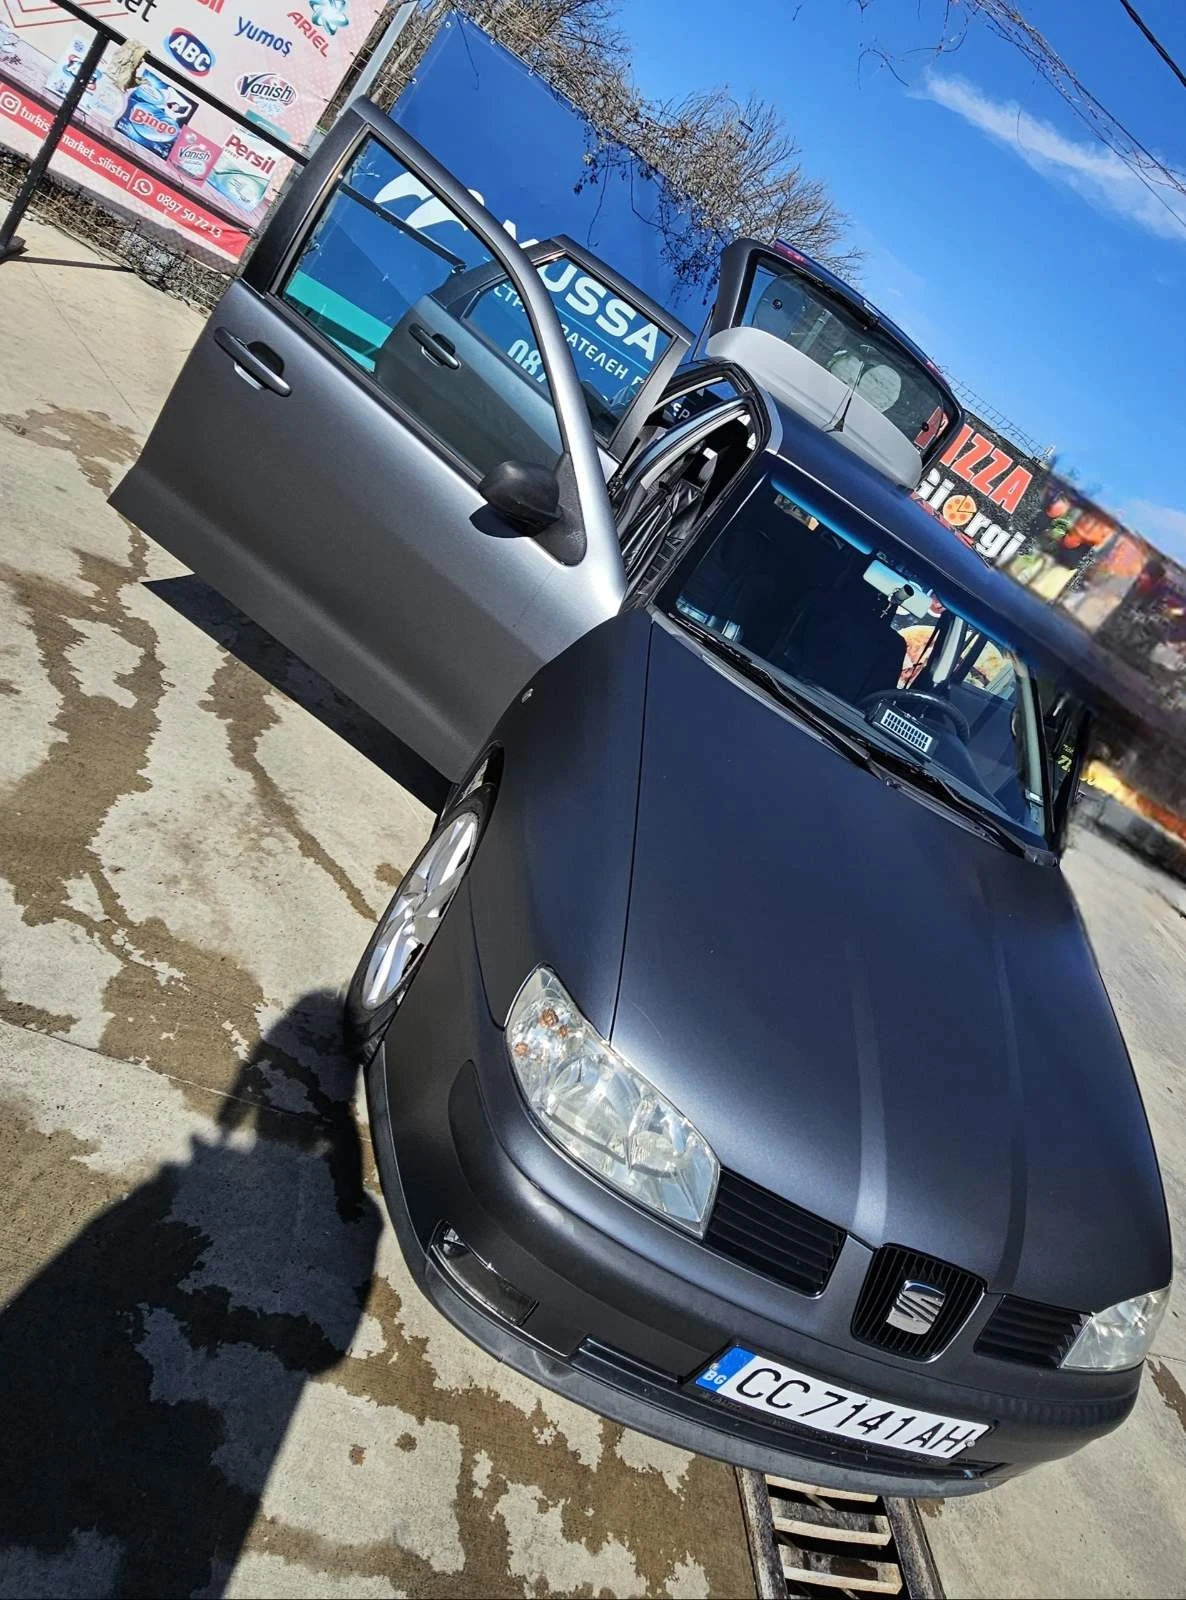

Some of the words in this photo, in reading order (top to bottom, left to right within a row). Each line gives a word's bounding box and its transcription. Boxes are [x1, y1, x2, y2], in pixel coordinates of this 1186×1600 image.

[287, 11, 331, 58] ARIEL
[169, 34, 211, 72] ABC
[240, 72, 295, 104] Vanish
[130, 108, 177, 136] Bingo
[178, 145, 211, 161] Vanish
[225, 134, 276, 174] Persil
[703, 1370, 727, 1385] BG
